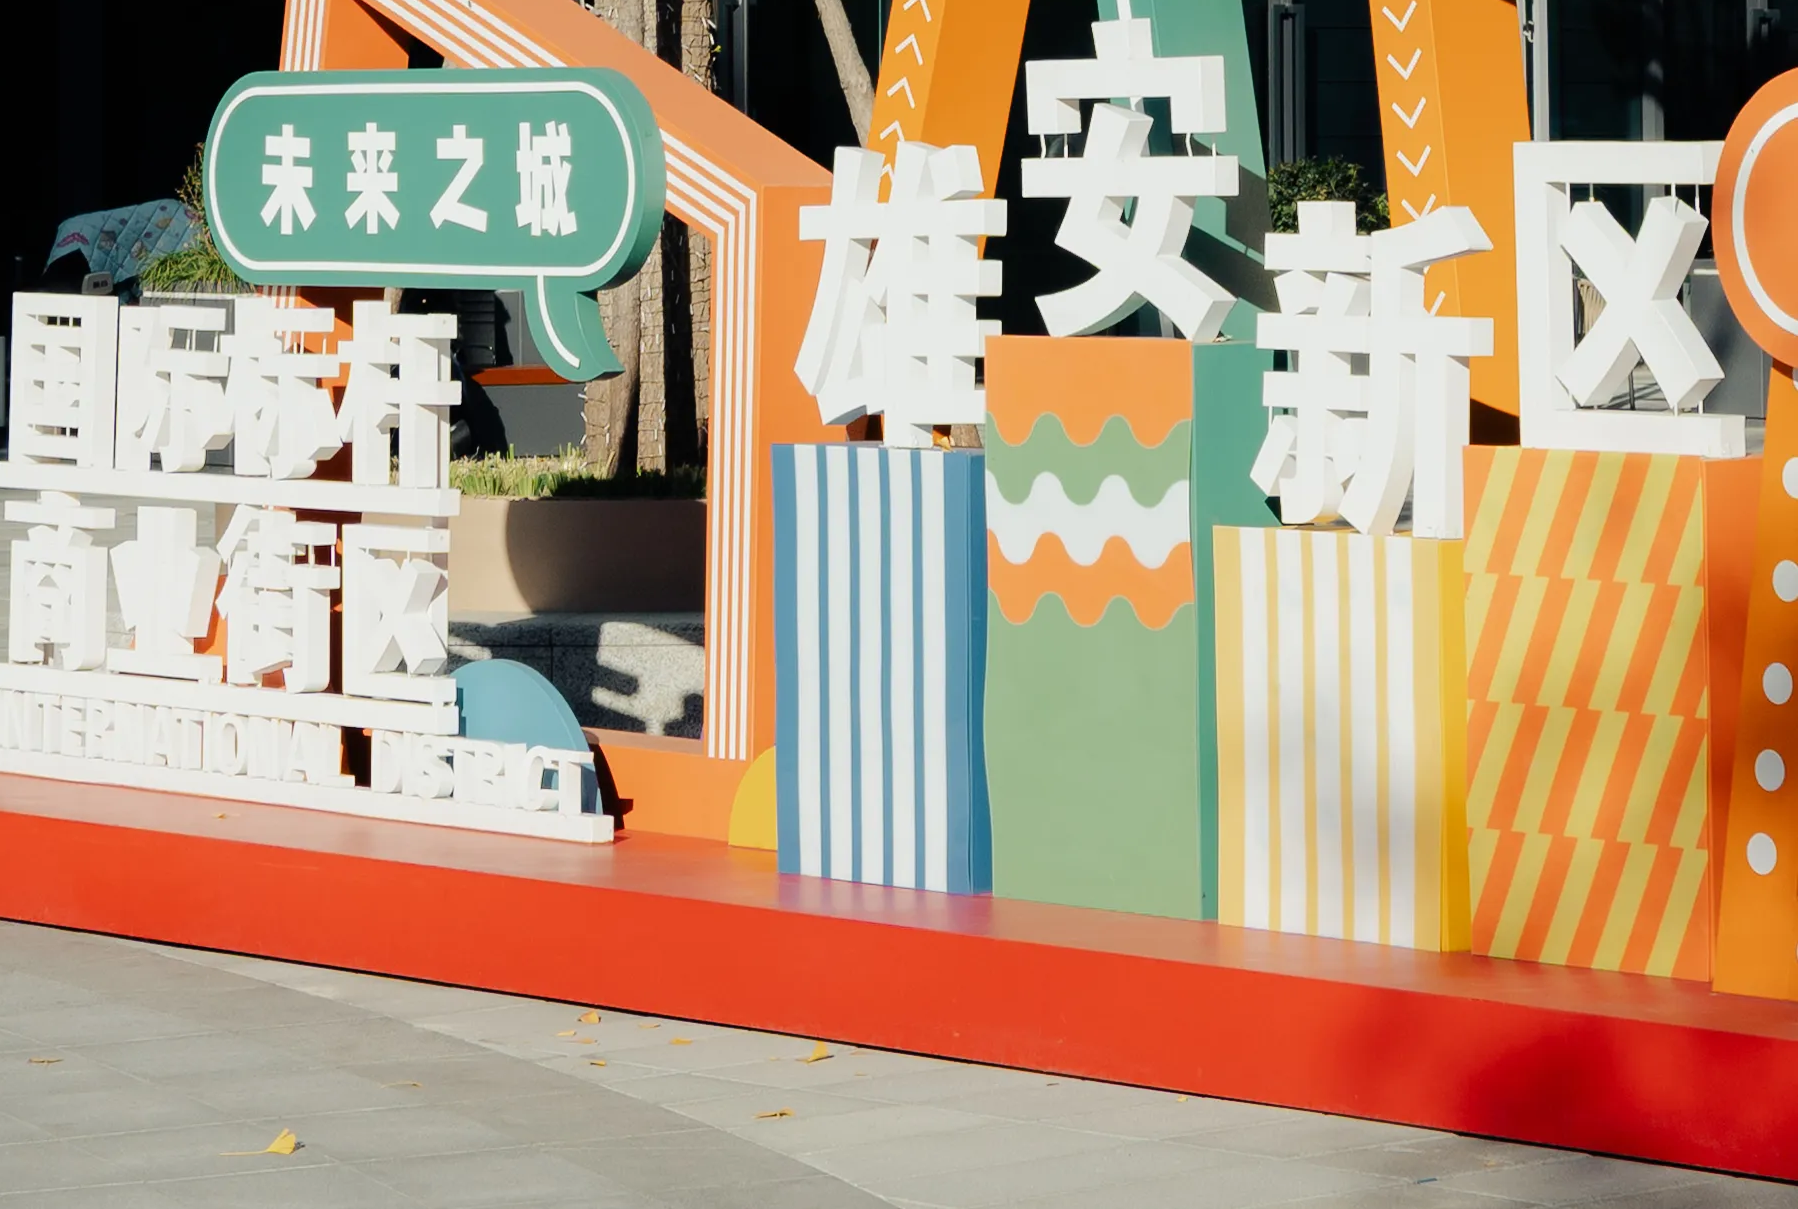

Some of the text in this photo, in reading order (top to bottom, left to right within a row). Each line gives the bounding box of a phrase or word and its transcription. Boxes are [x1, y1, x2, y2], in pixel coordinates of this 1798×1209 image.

[259, 121, 578, 238] 未来之城
[794, 17, 1747, 540] 雄安新区
[4, 491, 457, 703] 商业街区
[371, 728, 594, 816] DISTRICT
